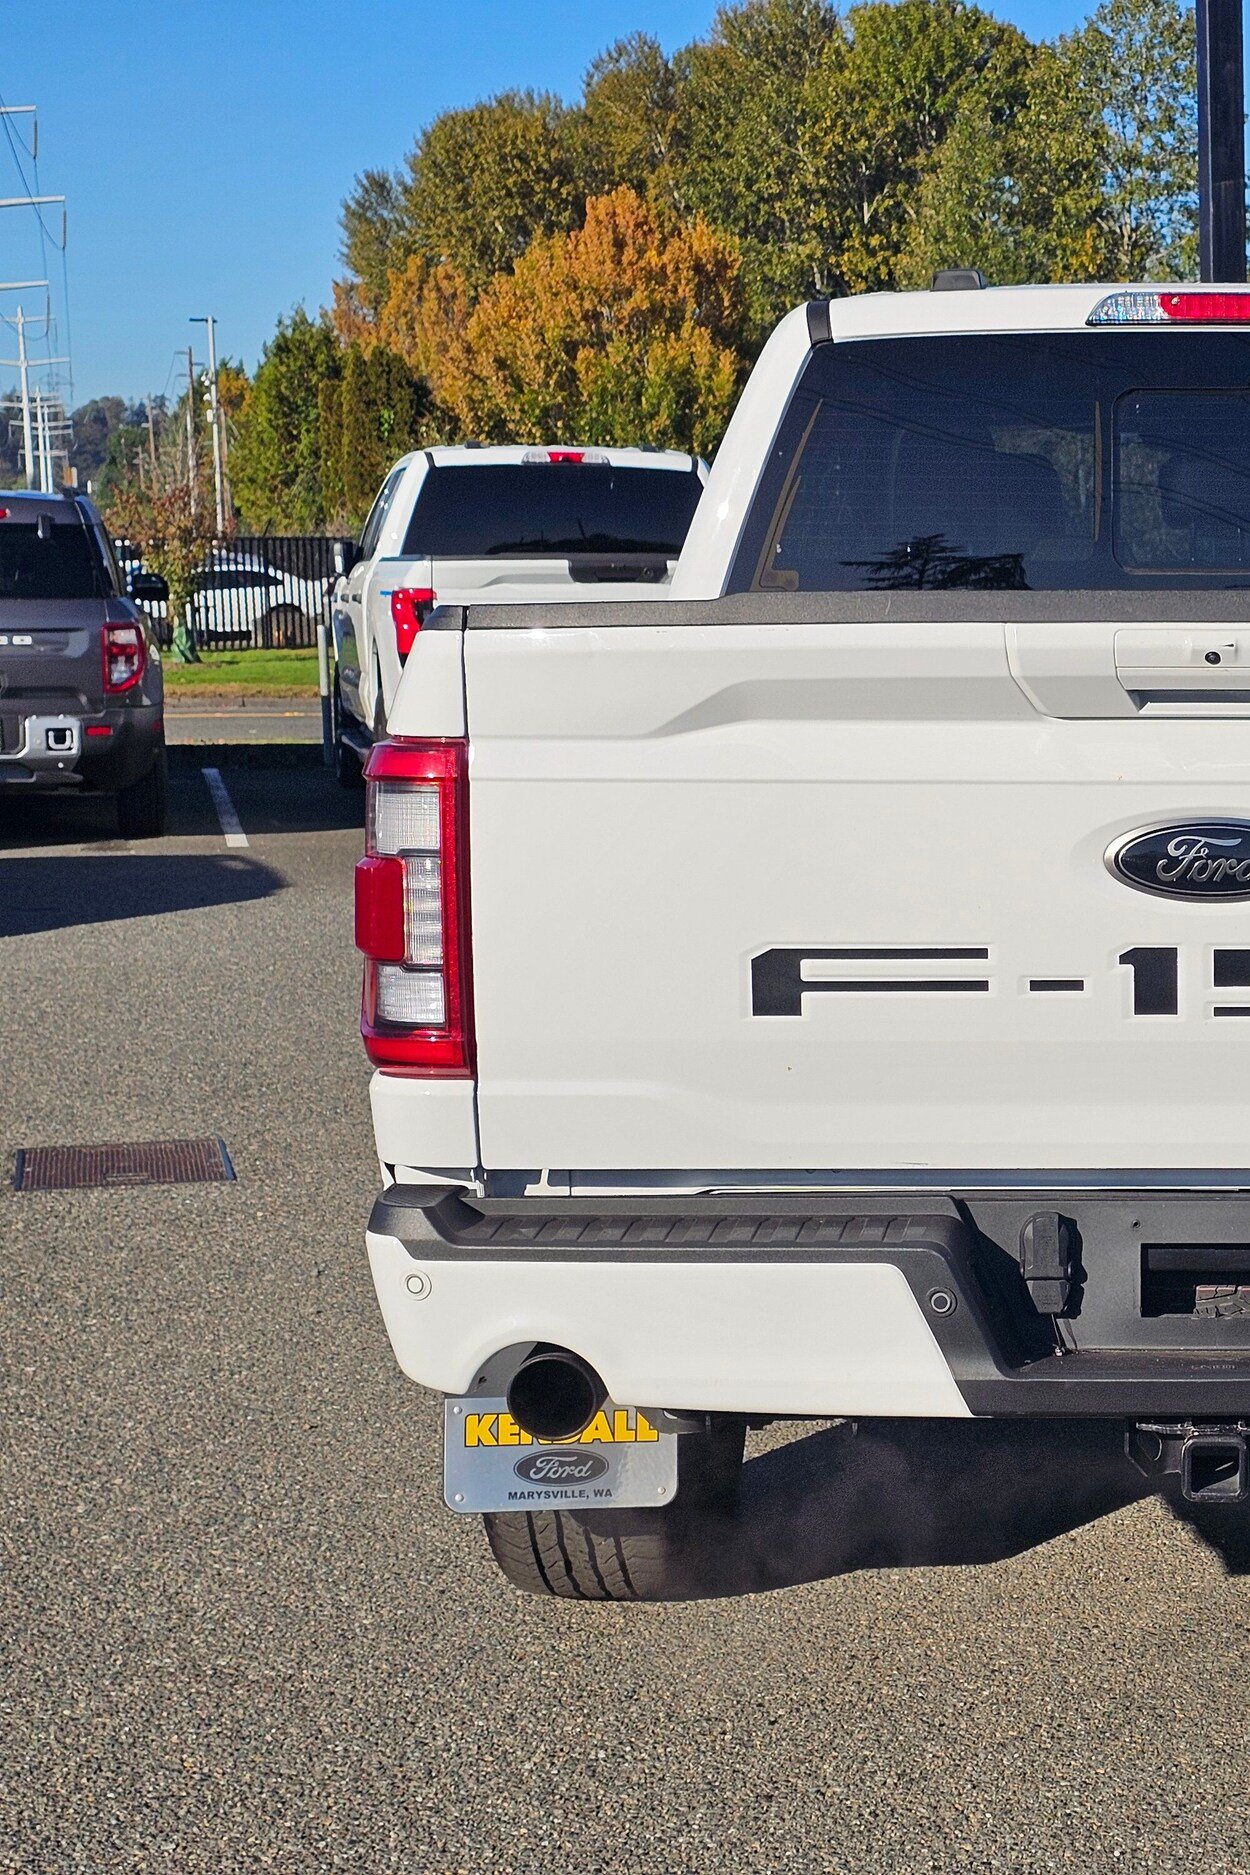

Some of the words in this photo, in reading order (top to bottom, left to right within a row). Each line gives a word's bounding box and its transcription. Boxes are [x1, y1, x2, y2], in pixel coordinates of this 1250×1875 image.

[464, 1409, 660, 1448] KEALL
[529, 1455, 593, 1480] Ford
[508, 1489, 590, 1501] MARYSVILLE,
[593, 1488, 613, 1499] WA
